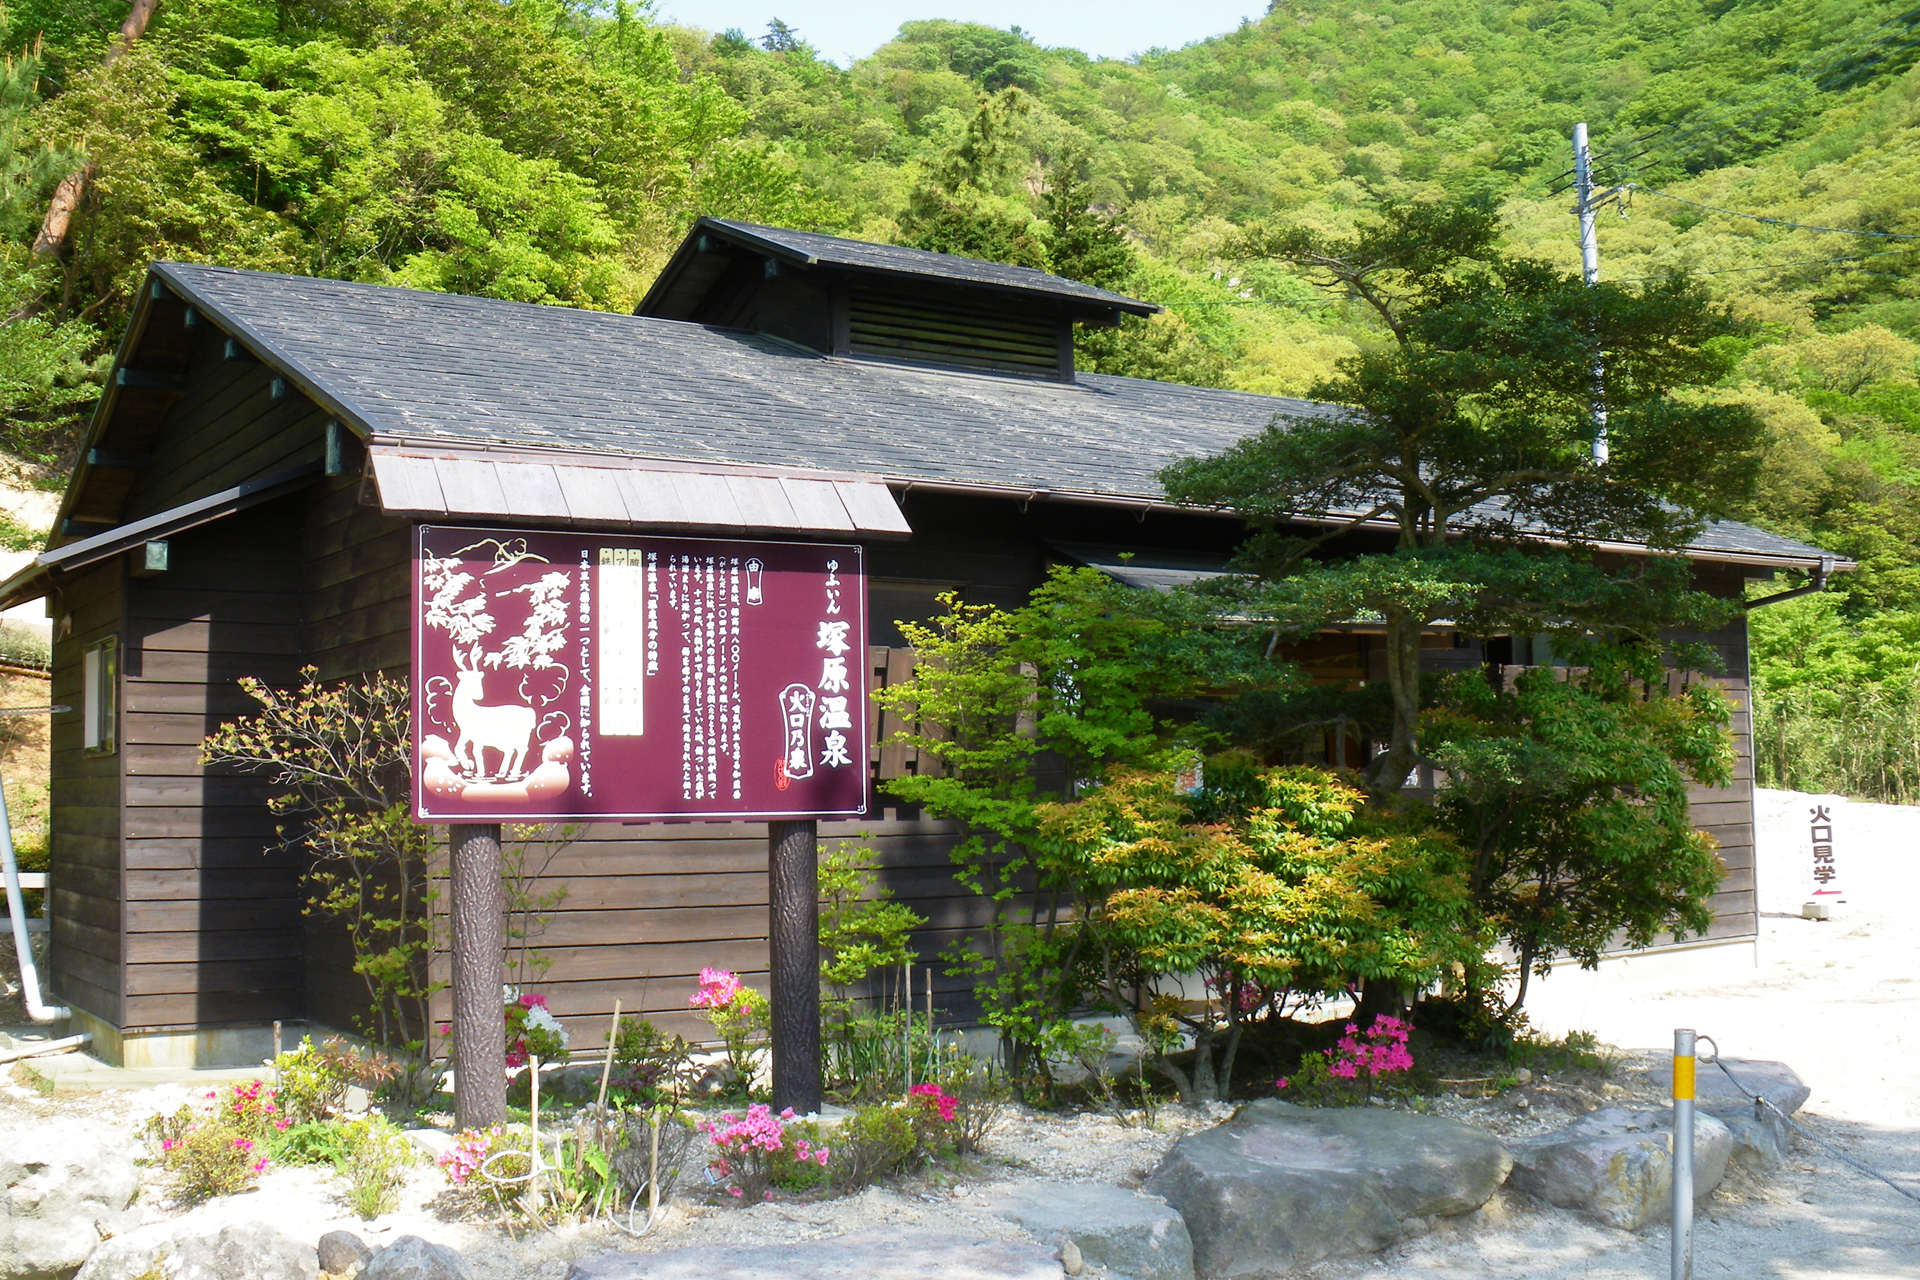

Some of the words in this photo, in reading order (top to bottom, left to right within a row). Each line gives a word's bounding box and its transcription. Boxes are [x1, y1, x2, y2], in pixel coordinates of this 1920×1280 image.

[668, 554, 679, 610] られています。
[748, 560, 761, 600] 由来
[824, 559, 841, 614] ゆふいん
[816, 621, 852, 768] 塚原温泉
[789, 690, 807, 770] 火口乃泉
[1809, 805, 1836, 884] 火口見学
